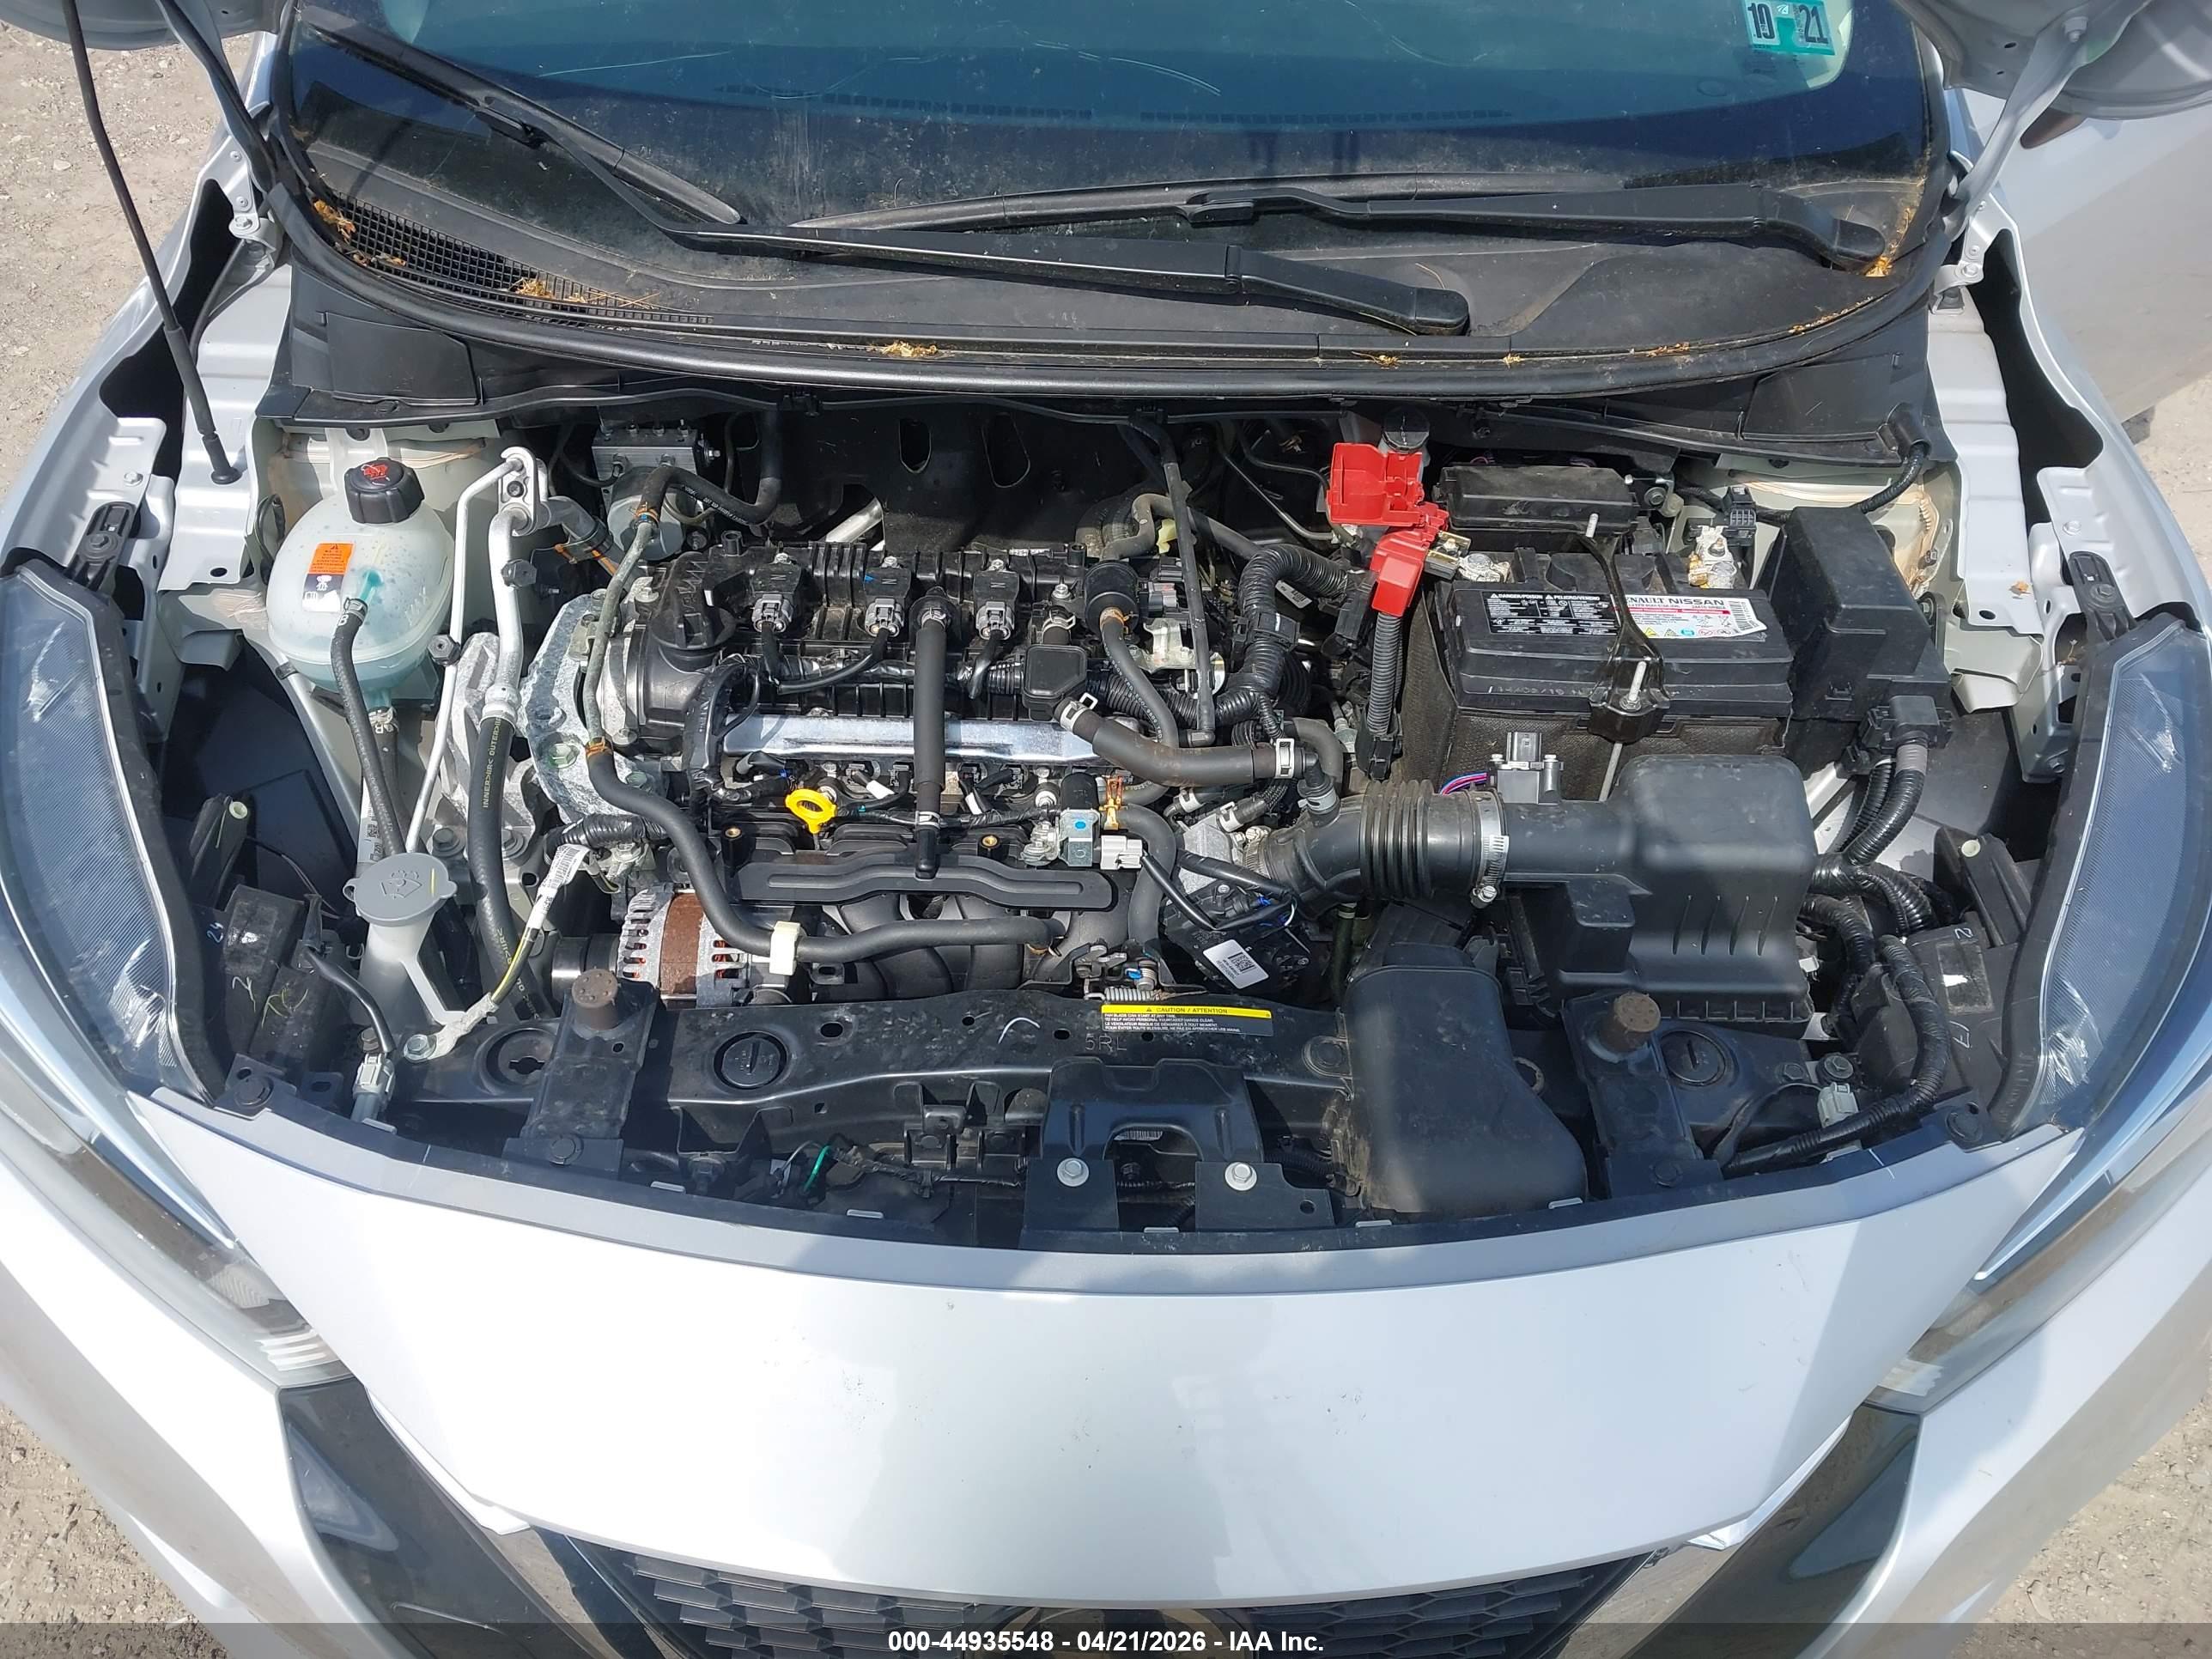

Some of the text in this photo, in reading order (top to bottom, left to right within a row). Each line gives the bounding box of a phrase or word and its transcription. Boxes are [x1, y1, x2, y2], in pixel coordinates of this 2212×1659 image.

[1747, 3, 1776, 40] 10
[1799, 4, 1829, 44] 21
[1668, 598, 1724, 606] NISSAN
